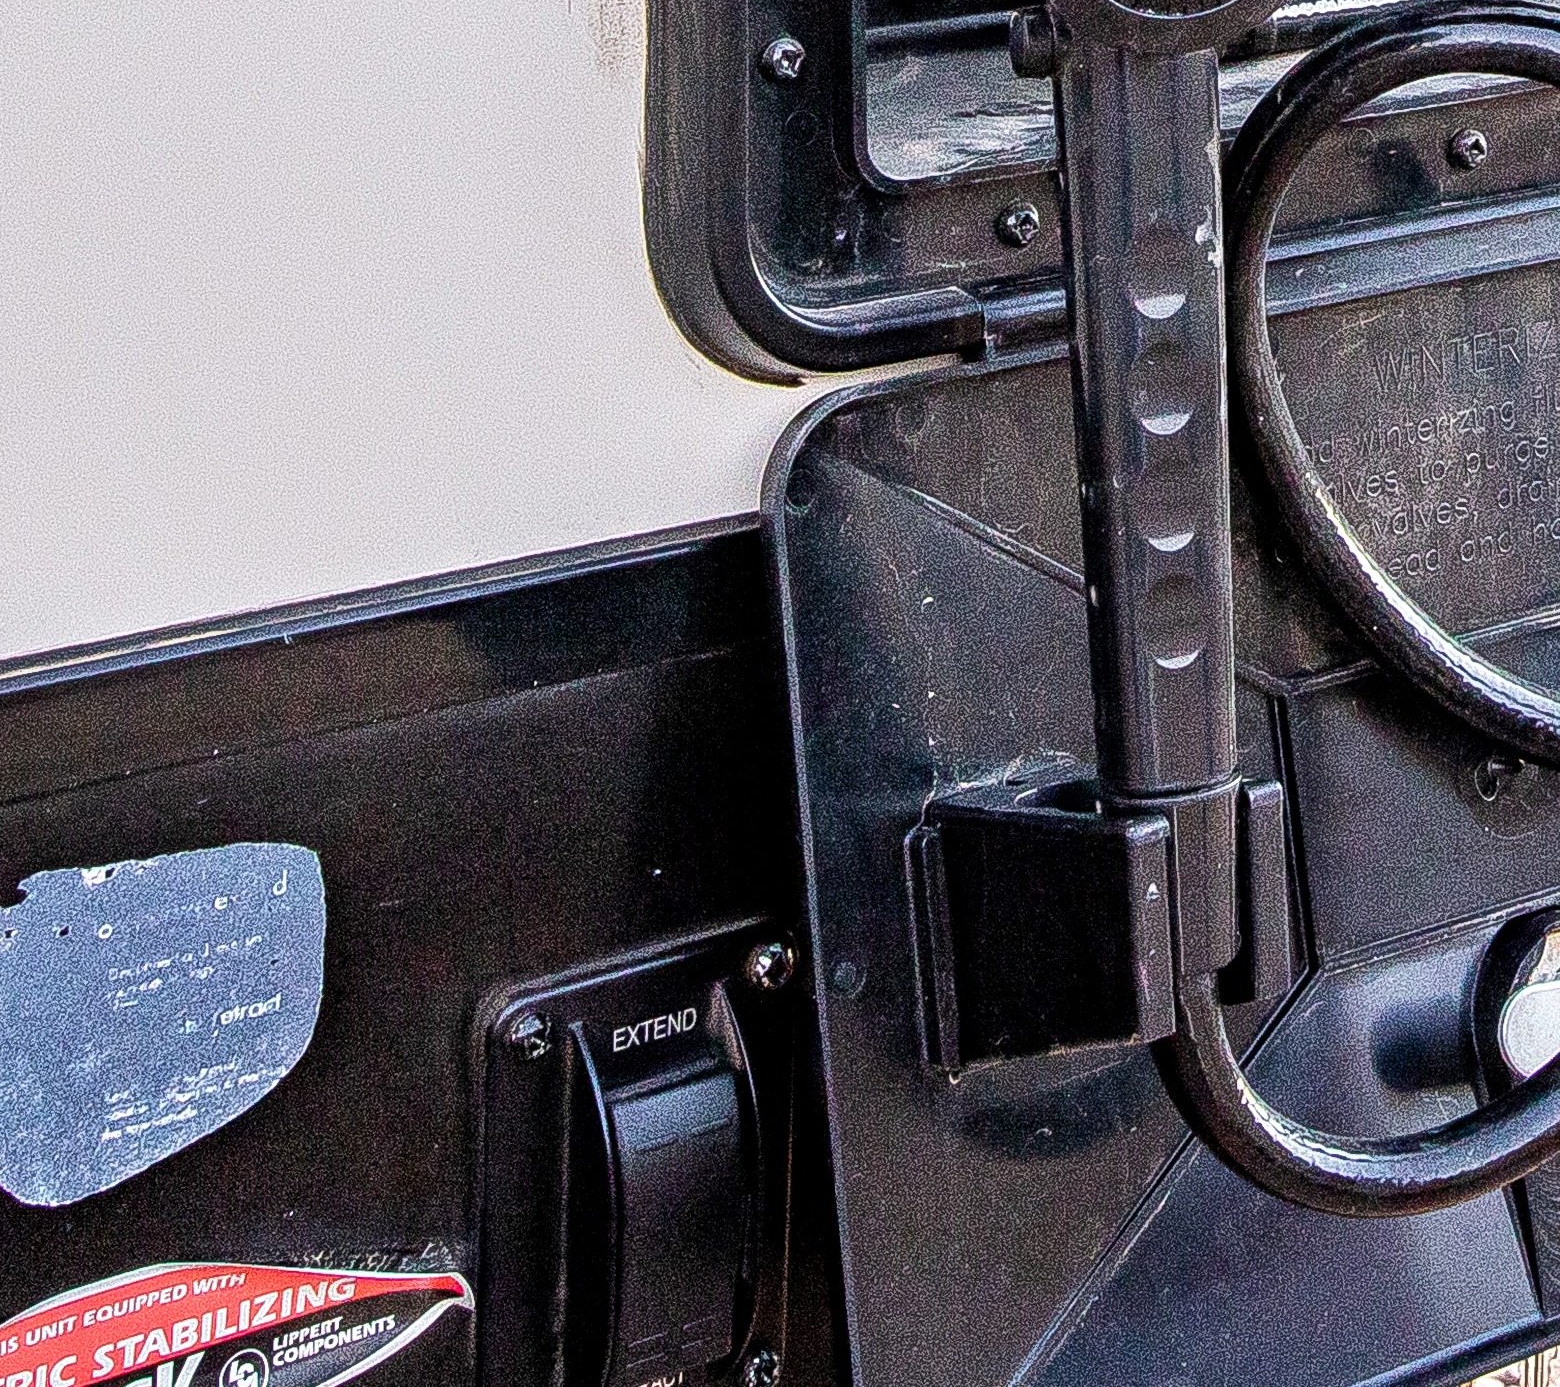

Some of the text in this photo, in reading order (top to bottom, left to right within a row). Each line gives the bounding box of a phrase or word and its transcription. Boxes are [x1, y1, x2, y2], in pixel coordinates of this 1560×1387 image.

[1415, 454, 1450, 485] to
[1387, 538, 1442, 579] ead
[613, 1008, 697, 1052] EXTEND
[25, 1316, 79, 1346] UNIT
[82, 1283, 188, 1328] EQUIPPED
[192, 1272, 247, 1296] WITH
[92, 1277, 357, 1378] STABILIZING
[272, 1315, 344, 1352] LIPPERT
[272, 1313, 397, 1367] COMPONENTS
